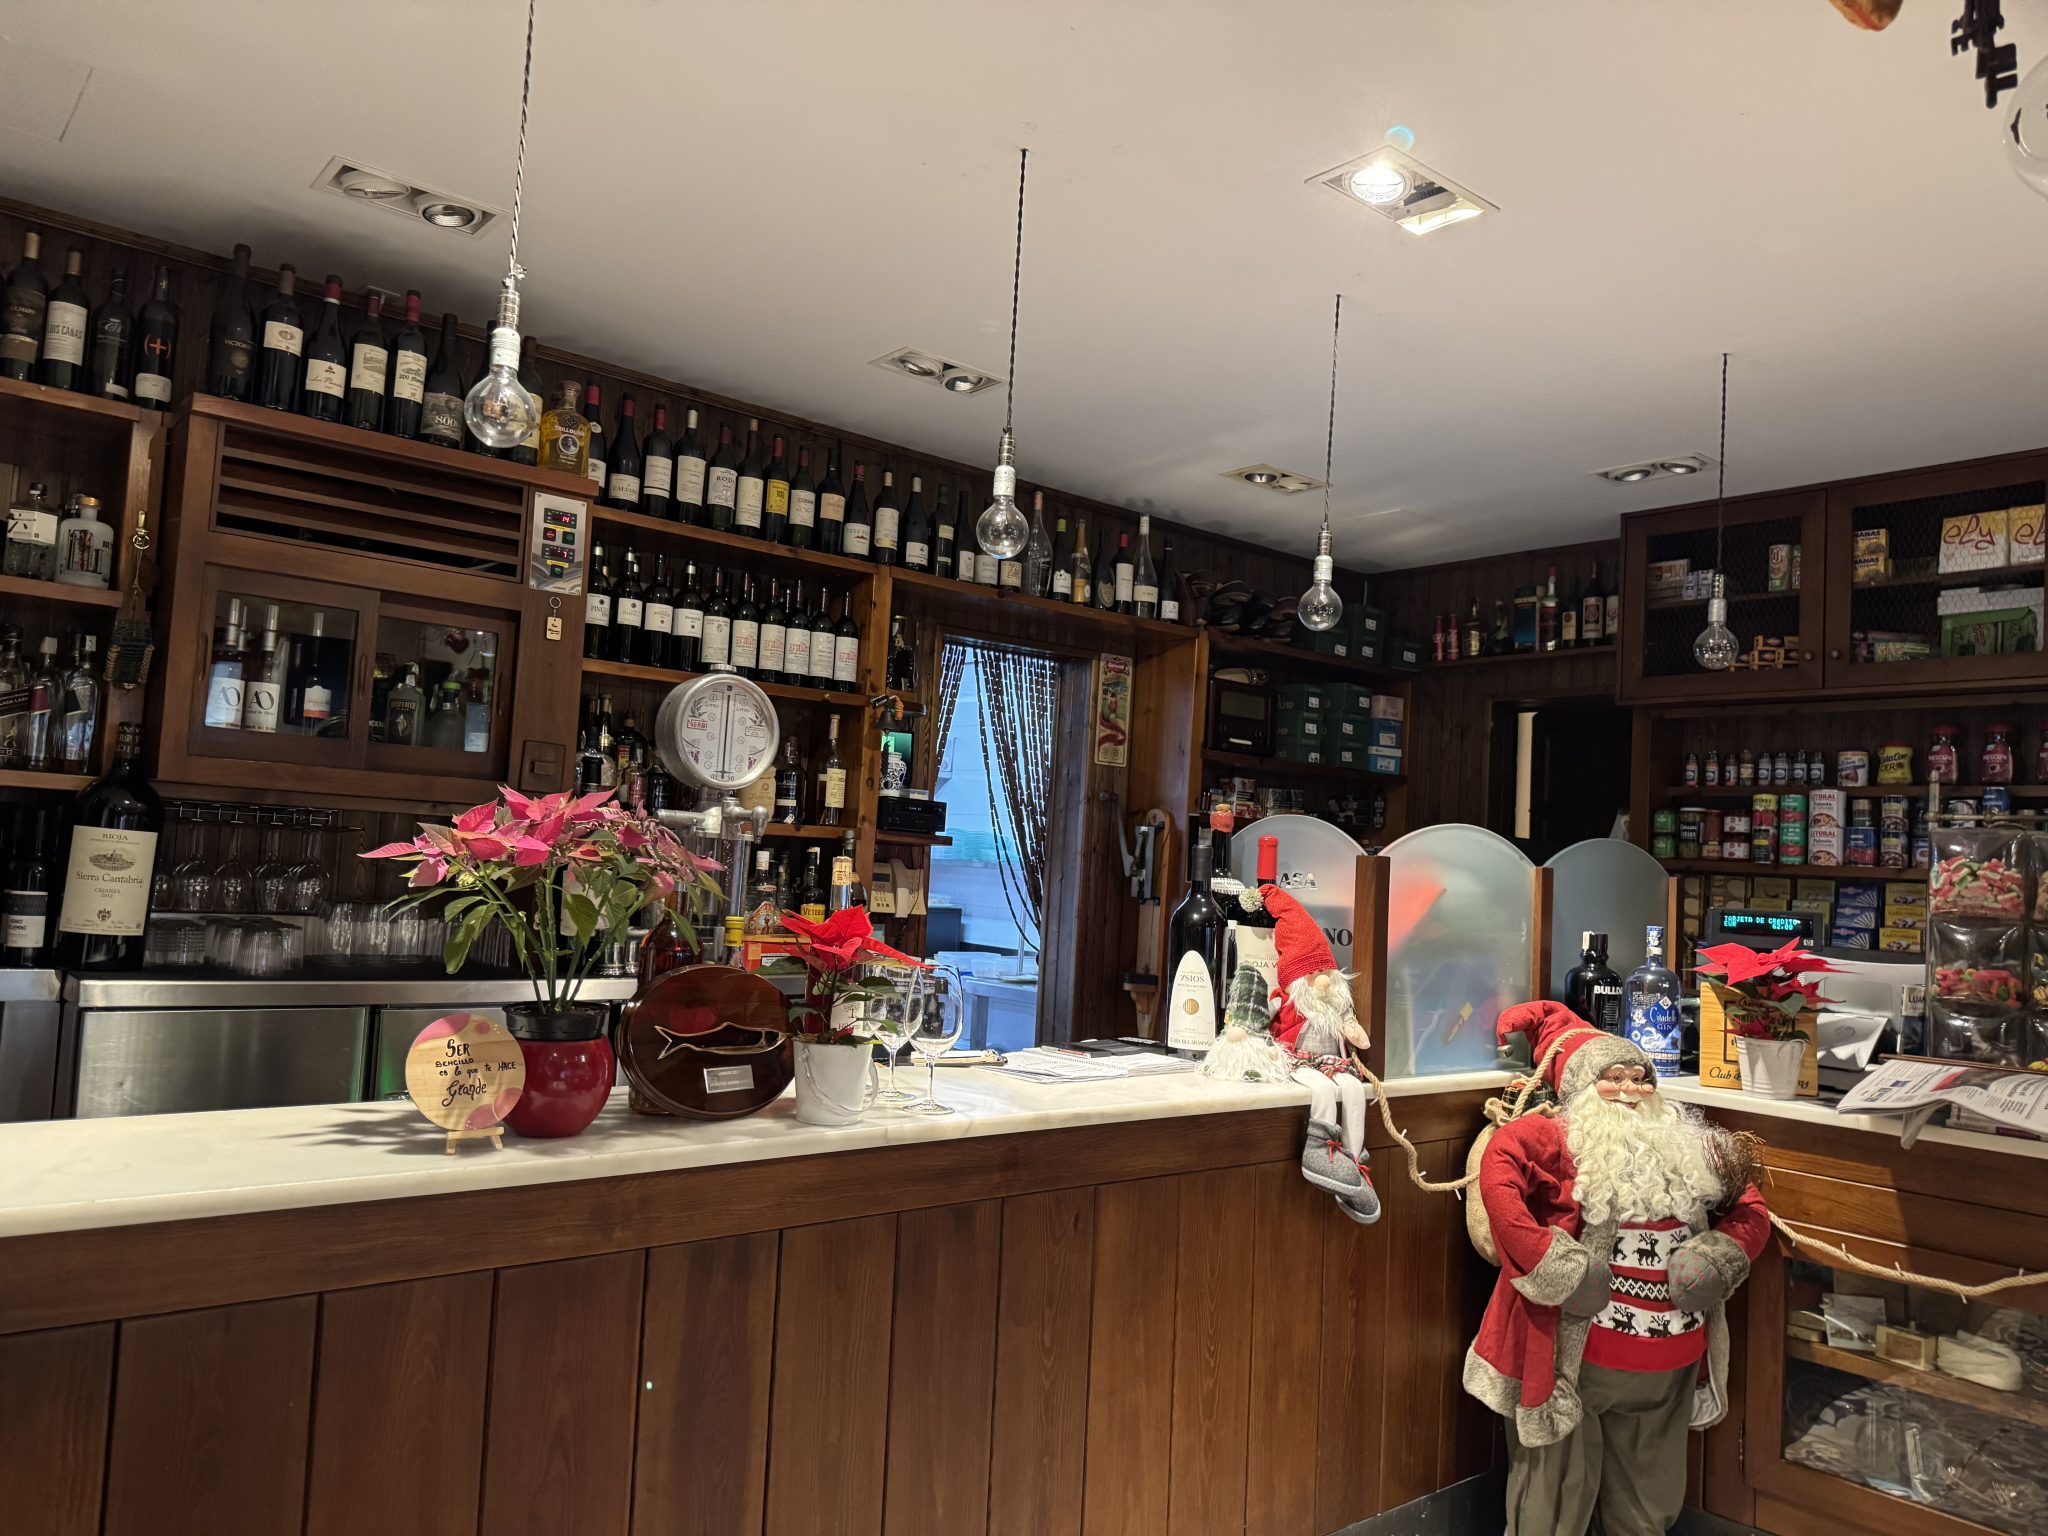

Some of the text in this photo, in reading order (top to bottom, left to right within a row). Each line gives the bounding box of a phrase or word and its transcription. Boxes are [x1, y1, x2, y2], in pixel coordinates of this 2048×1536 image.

[102, 832, 129, 841] RIOJA
[1810, 830, 1836, 838] LITORAL
[75, 871, 144, 885] Sierra Cantabria
[1279, 872, 1318, 889] ASA
[1724, 915, 1753, 923] TARJETA
[445, 1038, 471, 1058] SER
[454, 1066, 462, 1077] lo
[466, 1068, 479, 1078] que
[484, 1063, 492, 1072] te
[498, 1061, 517, 1071] HACE
[1709, 1066, 1732, 1079] Club
[441, 1078, 487, 1107] Grande
